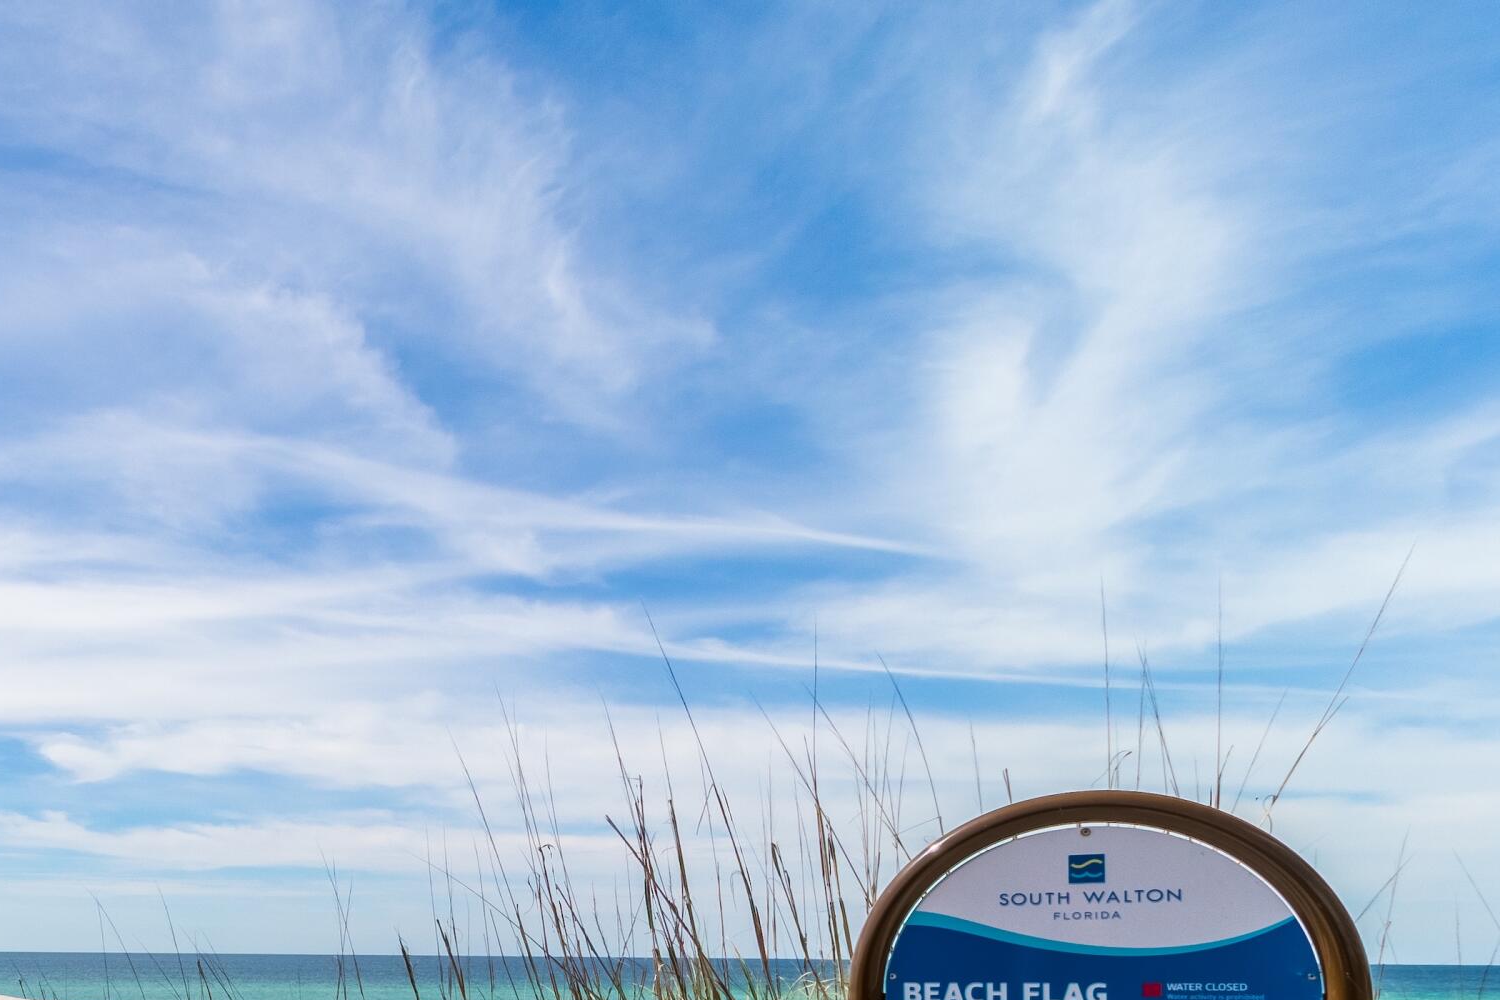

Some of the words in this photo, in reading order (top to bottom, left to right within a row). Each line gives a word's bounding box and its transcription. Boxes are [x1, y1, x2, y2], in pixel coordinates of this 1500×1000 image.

[999, 891, 1070, 906] SOUTH
[1083, 888, 1183, 904] WALTON
[1053, 911, 1121, 920] FLORIDA
[1167, 983, 1202, 991] WATER
[1205, 983, 1248, 991] CLOSED
